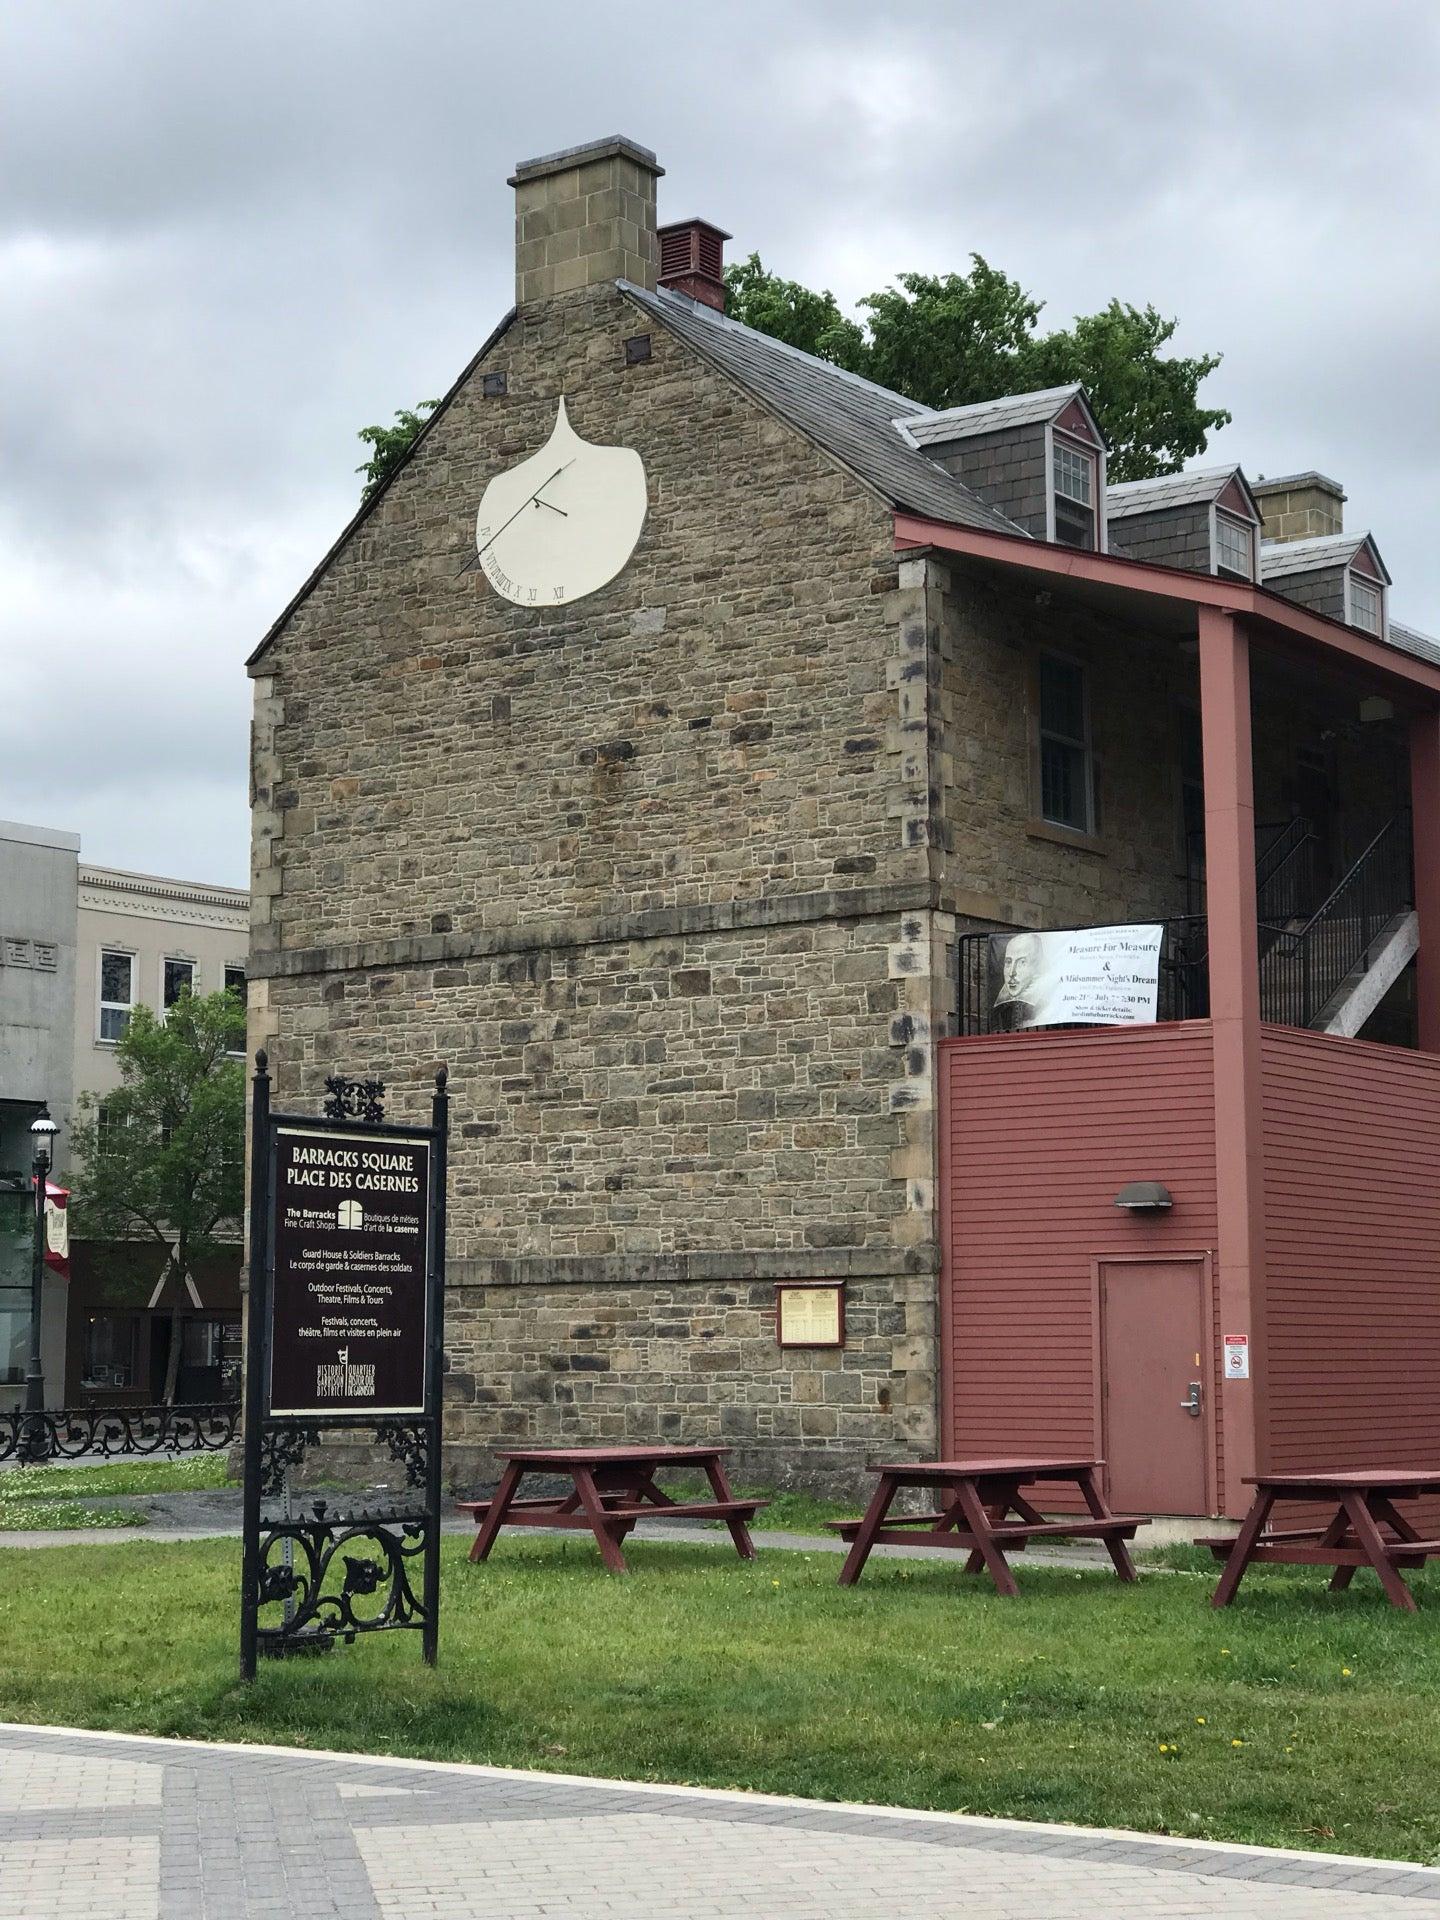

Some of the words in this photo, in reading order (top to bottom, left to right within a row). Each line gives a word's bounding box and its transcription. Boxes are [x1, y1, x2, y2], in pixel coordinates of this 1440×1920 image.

[527, 589, 537, 601] XI
[553, 586, 564, 600] XII
[1068, 945, 1102, 954] Measure
[1103, 943, 1117, 952] For
[1119, 942, 1158, 952] Measure
[1102, 961, 1111, 971] &
[1065, 975, 1104, 983] Midsummer
[1107, 974, 1130, 984] Night's
[1132, 975, 1157, 984] Dream
[293, 1147, 359, 1168] BARRACKS
[362, 1153, 413, 1172] SQUARE
[287, 1168, 325, 1186] PLACE
[329, 1171, 351, 1188] DES
[356, 1174, 418, 1193] CASERNES
[287, 1208, 301, 1217] The
[303, 1209, 336, 1219] Barracks
[364, 1213, 390, 1223] Boutiques
[391, 1214, 399, 1222] de
[400, 1215, 419, 1224] métiers
[285, 1219, 297, 1228] Fine
[299, 1220, 315, 1228] Craft
[317, 1221, 335, 1230] Shops
[364, 1224, 377, 1232] d'art
[378, 1224, 385, 1232] de
[386, 1224, 393, 1232] la
[303, 1249, 321, 1258] Guard
[322, 1251, 342, 1259] House
[343, 1250, 348, 1259] &
[349, 1251, 373, 1260] Soldiers
[375, 1252, 400, 1261] Barracks
[290, 1260, 297, 1268] Le
[298, 1262, 315, 1271] corps
[316, 1261, 325, 1269] de
[326, 1262, 343, 1271] garde
[344, 1262, 349, 1270] &
[378, 1262, 389, 1271] des
[391, 1263, 412, 1272] soldats
[308, 1283, 334, 1292] Outdoor
[336, 1284, 362, 1294] Festivals,
[364, 1285, 392, 1295] Concerts,
[317, 1294, 342, 1304] Theatre,
[344, 1295, 359, 1304] Films
[360, 1296, 365, 1304] &
[366, 1296, 383, 1304] Tours
[322, 1317, 349, 1326] Festivals,
[350, 1318, 378, 1326] concerts,
[323, 1328, 338, 1337] films
[347, 1328, 365, 1337] visites
[376, 1328, 392, 1340] plein
[393, 1329, 401, 1337] air
[318, 1365, 343, 1376] HISTORIC
[349, 1364, 375, 1375] QUARTIER
[317, 1376, 343, 1386] GARRISON
[317, 1386, 343, 1396] DISTRICT
